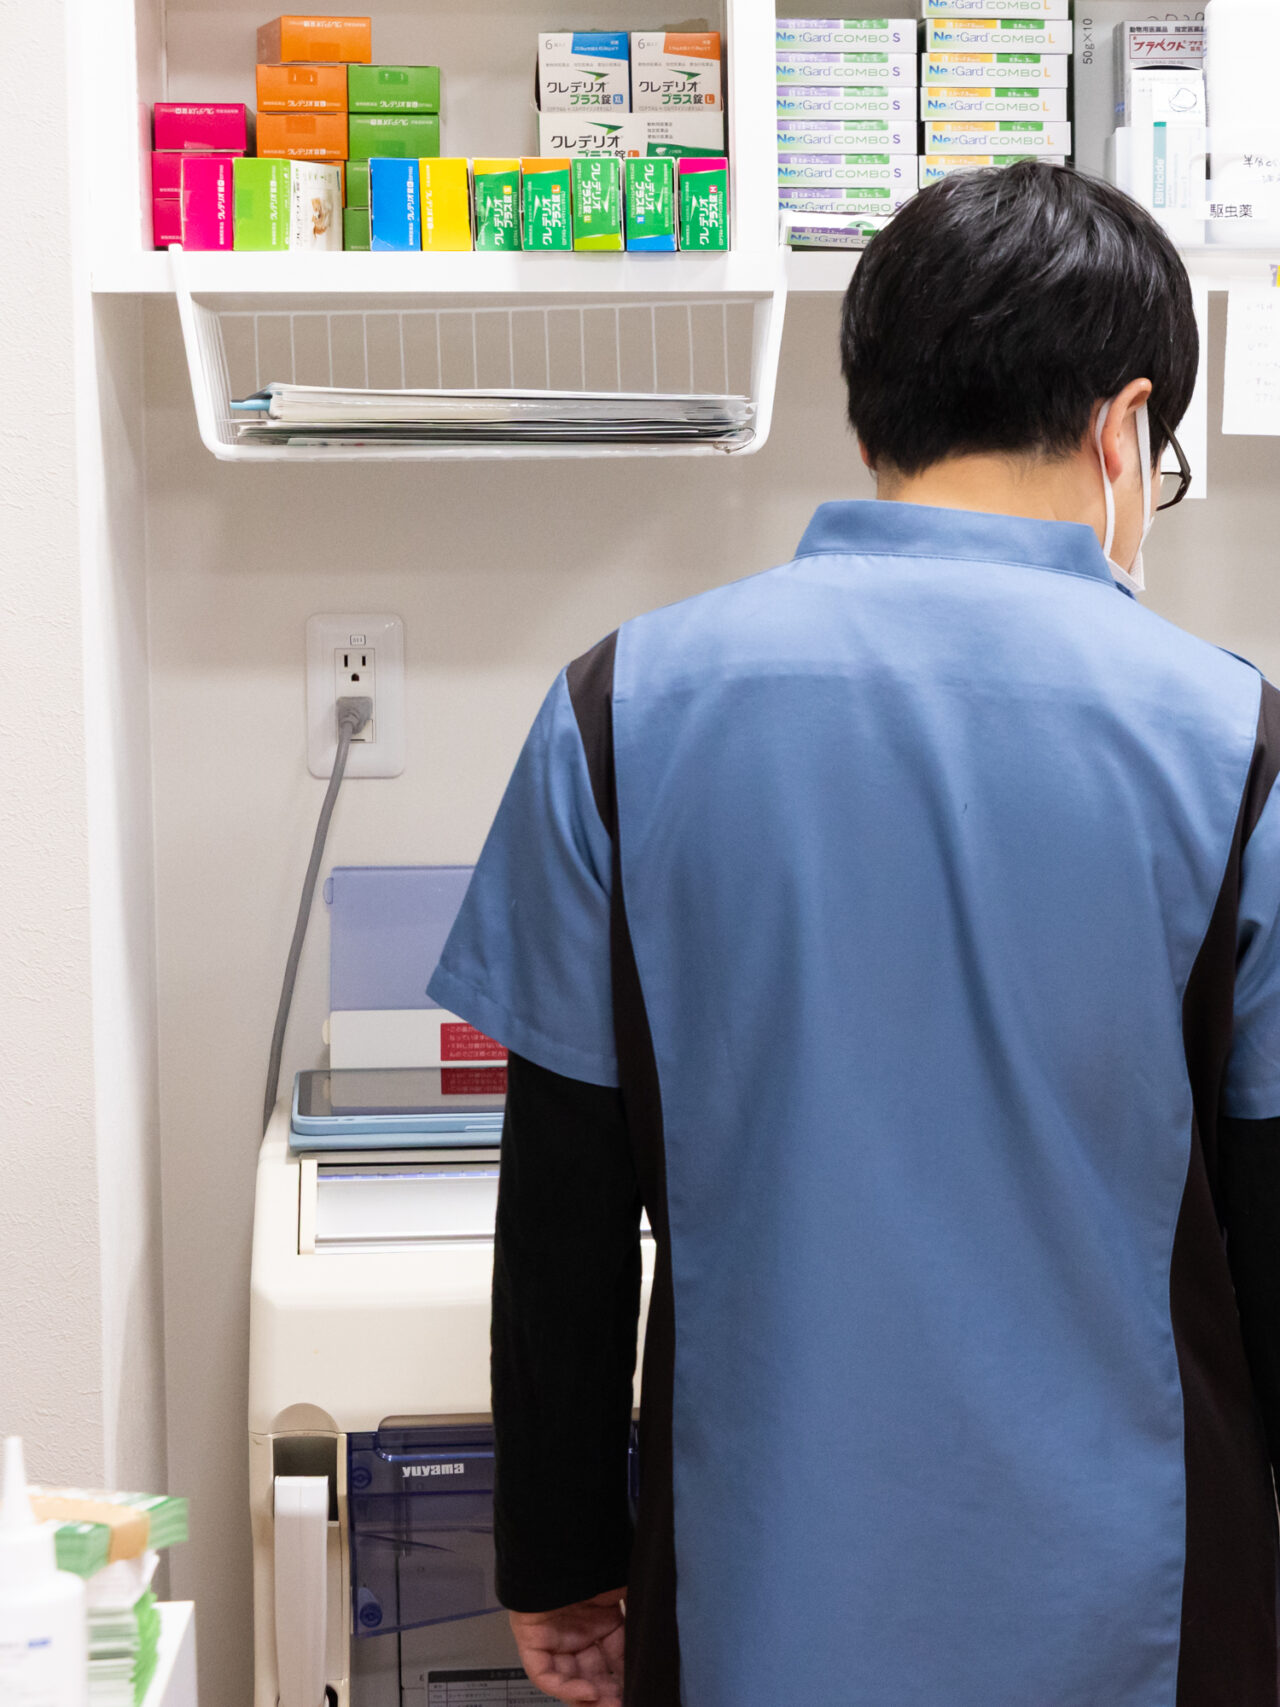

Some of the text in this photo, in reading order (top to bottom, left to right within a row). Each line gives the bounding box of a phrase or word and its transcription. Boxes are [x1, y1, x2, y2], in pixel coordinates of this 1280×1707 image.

[986, 1, 1040, 10] COMBO
[1044, 0, 1051, 10] L
[834, 34, 889, 43] COMBO
[892, 32, 901, 43] S
[991, 34, 1046, 44] COMBO
[1048, 33, 1056, 44] L
[833, 68, 889, 76] COMBO
[892, 66, 901, 76] S
[986, 68, 1041, 78] COMBO
[1044, 67, 1051, 78] L
[546, 82, 606, 93] クレデリオ
[638, 81, 698, 92] クレデリオ
[570, 94, 611, 105] プラス錠
[662, 94, 703, 104] プラス錠
[833, 102, 889, 110] COMBO
[892, 100, 901, 110] S
[985, 102, 1040, 112] COMBO
[1042, 101, 1050, 112] L
[550, 136, 620, 148] クレデリオ
[834, 136, 889, 144] COMBO
[892, 134, 901, 144] S
[990, 136, 1044, 145] COMBO
[1048, 136, 1054, 145] L
[835, 170, 890, 178] COMBO
[894, 168, 902, 178] S
[592, 162, 602, 210] クレデリオ
[644, 163, 654, 211] クレデリオ
[1210, 204, 1253, 218] 駆虫薬
[494, 198, 504, 246] クレデリオ
[542, 198, 553, 245] クレデリオ
[700, 198, 710, 245] クレデリオ
[402, 1462, 464, 1478] yuyama
